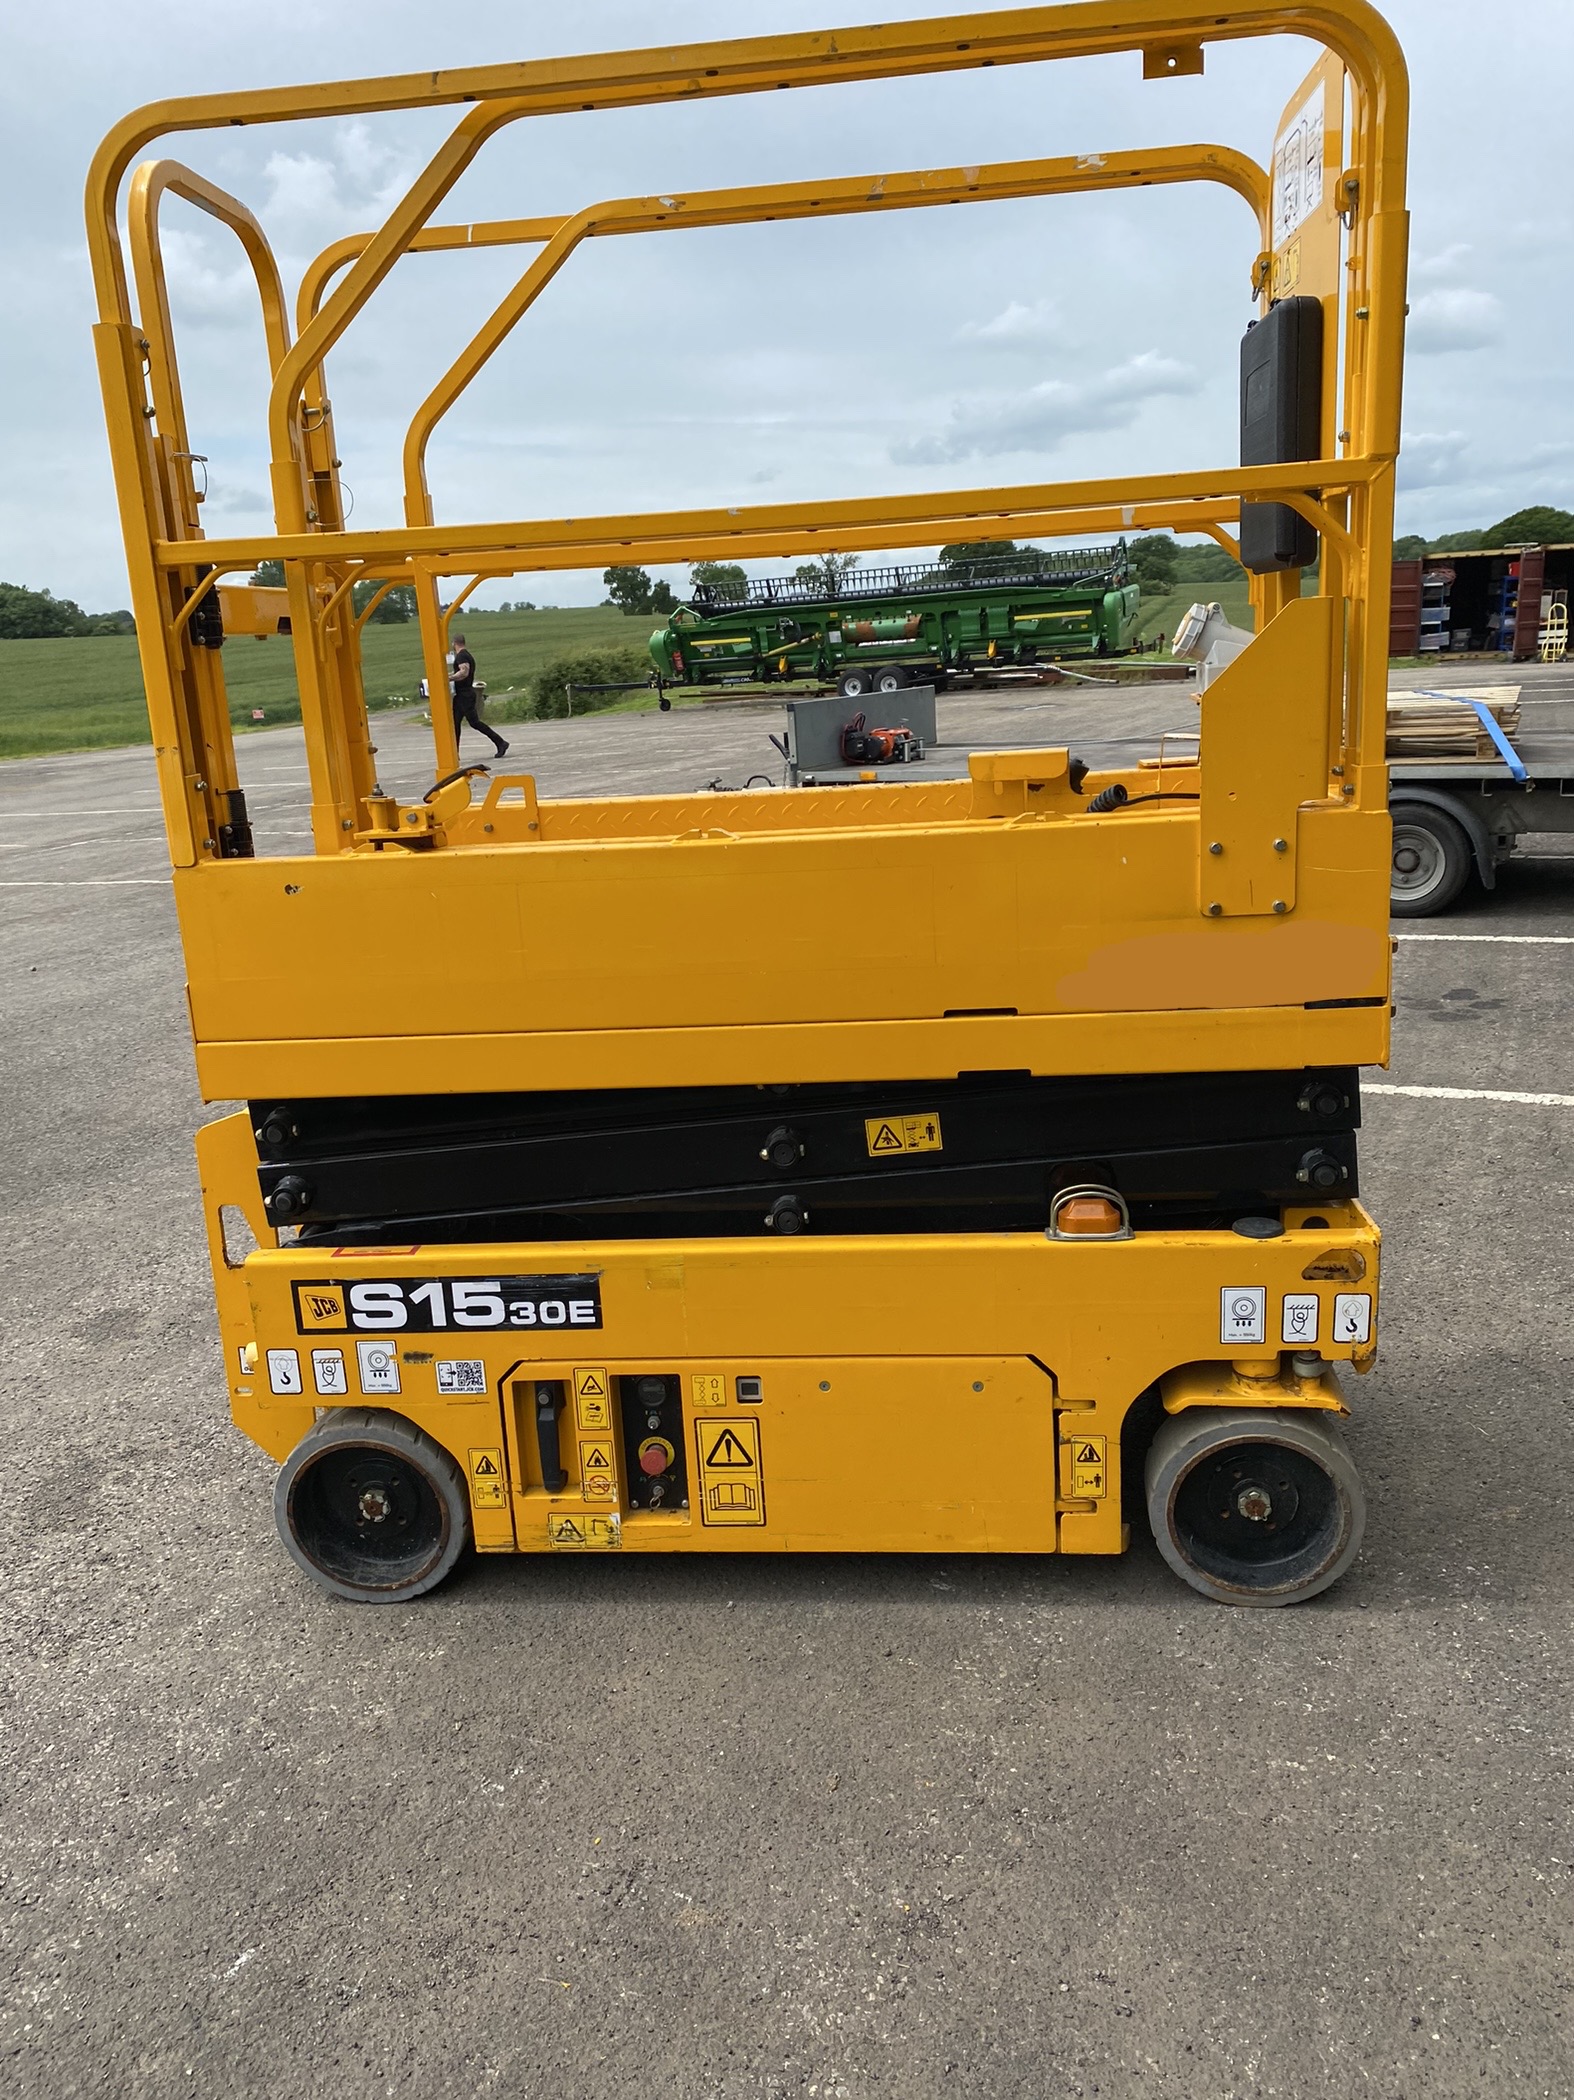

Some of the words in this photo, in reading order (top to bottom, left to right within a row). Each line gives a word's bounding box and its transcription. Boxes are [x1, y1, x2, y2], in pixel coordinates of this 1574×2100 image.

[311, 1297, 339, 1317] JCB
[350, 1281, 506, 1329] S15
[509, 1300, 596, 1325] 30E
